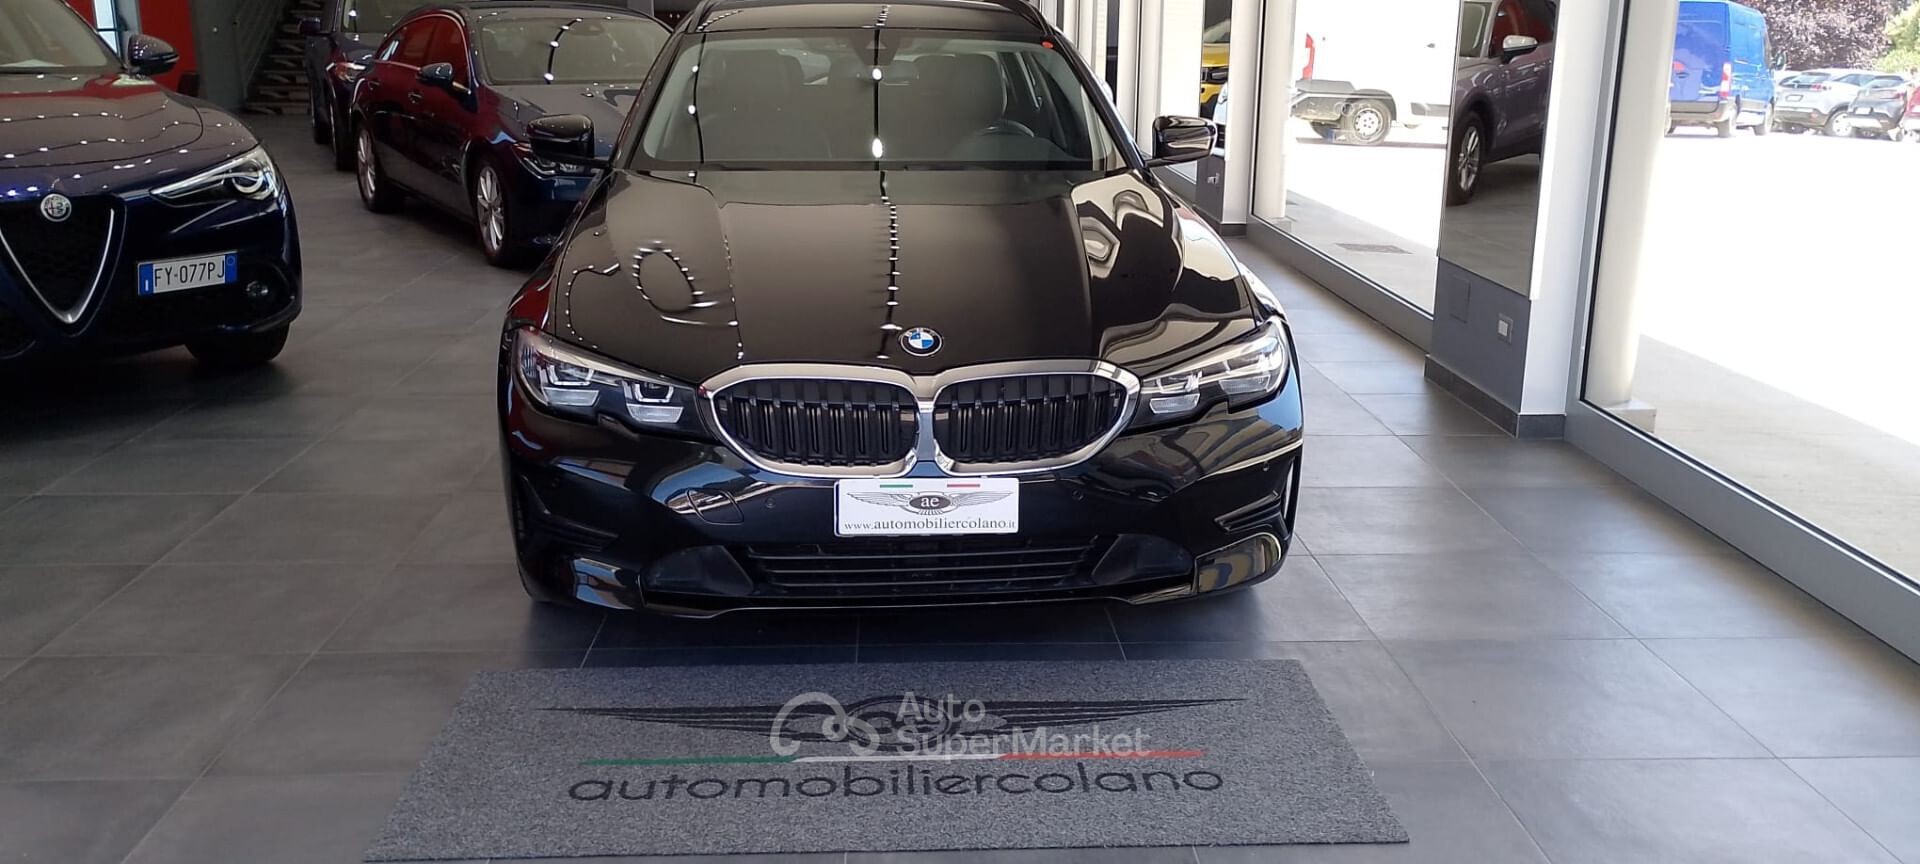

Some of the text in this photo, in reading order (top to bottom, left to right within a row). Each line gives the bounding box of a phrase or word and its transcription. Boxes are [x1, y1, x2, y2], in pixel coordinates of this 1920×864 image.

[920, 497, 941, 508] ae
[844, 517, 1016, 530] www.automobiliercolano.it
[568, 762, 1223, 801] automobiliercolano
